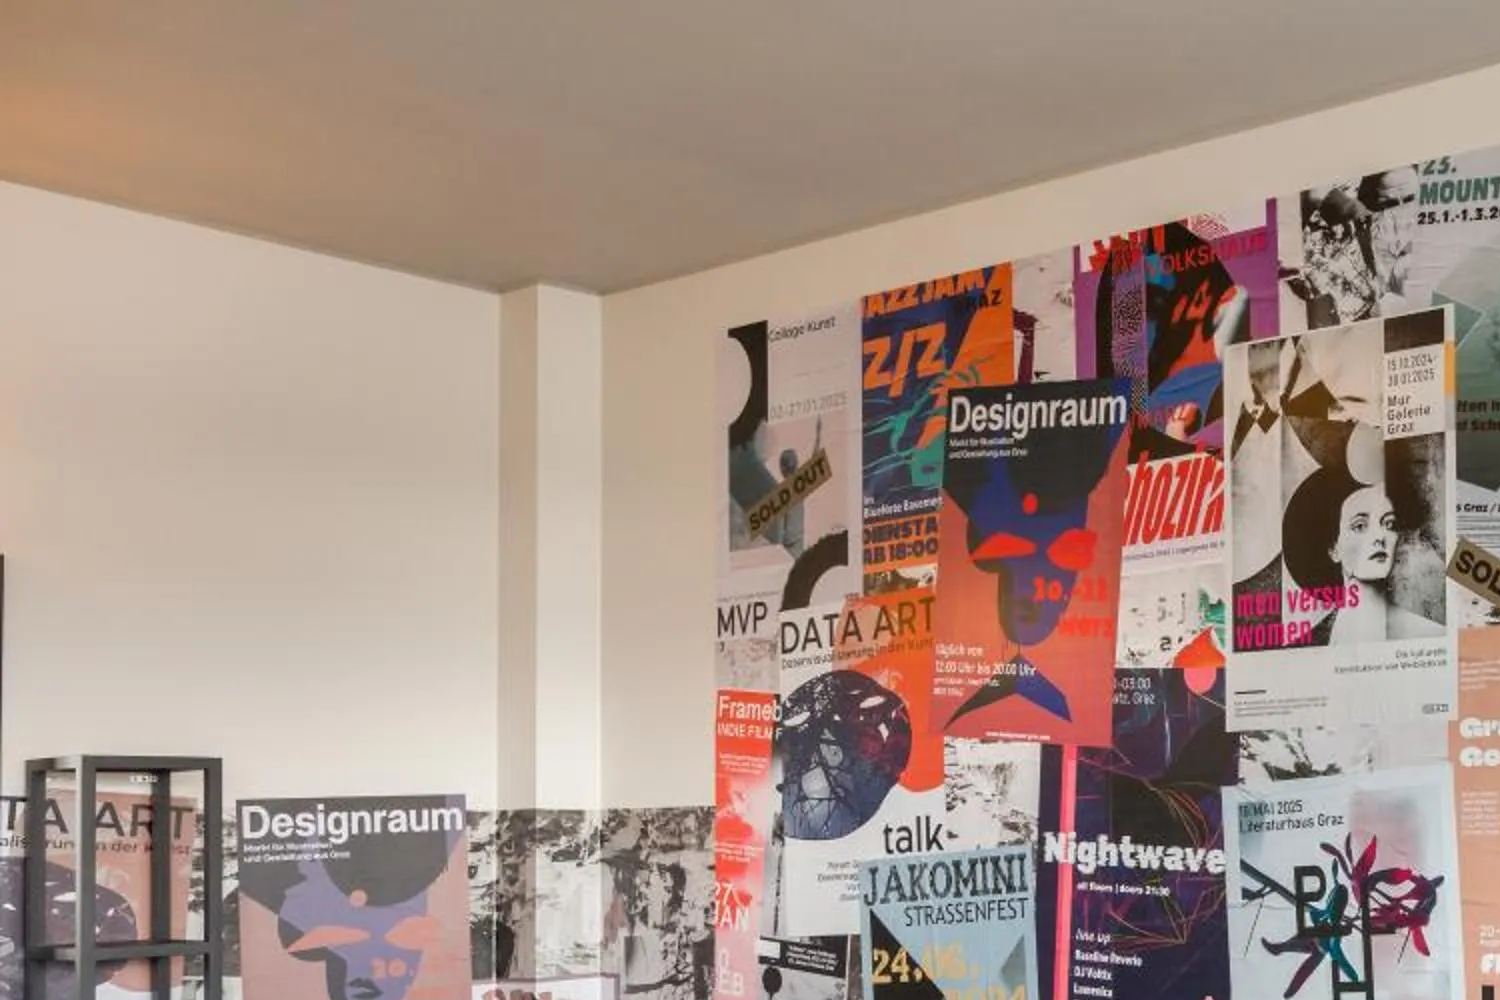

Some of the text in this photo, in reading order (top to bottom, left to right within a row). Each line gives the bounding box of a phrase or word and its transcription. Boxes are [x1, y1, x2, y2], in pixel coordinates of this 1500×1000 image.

[950, 393, 1127, 439] Designraum
[1387, 395, 1412, 407] Mur
[1387, 405, 1431, 421] Galerie
[1387, 422, 1414, 435] Graz
[748, 455, 828, 531] SOLD OUT
[1235, 583, 1361, 618] men versus
[717, 601, 768, 637] MVP
[781, 596, 937, 654] DATA ART
[1235, 620, 1313, 649] women
[241, 803, 463, 845] Designraum
[1277, 800, 1303, 815] 2025
[1317, 814, 1344, 828] Graz
[883, 815, 945, 855] talk
[1043, 832, 1226, 875] Nightwave
[863, 853, 1029, 907] JAKOMINI
[904, 897, 1029, 927] STRASSENFEST
